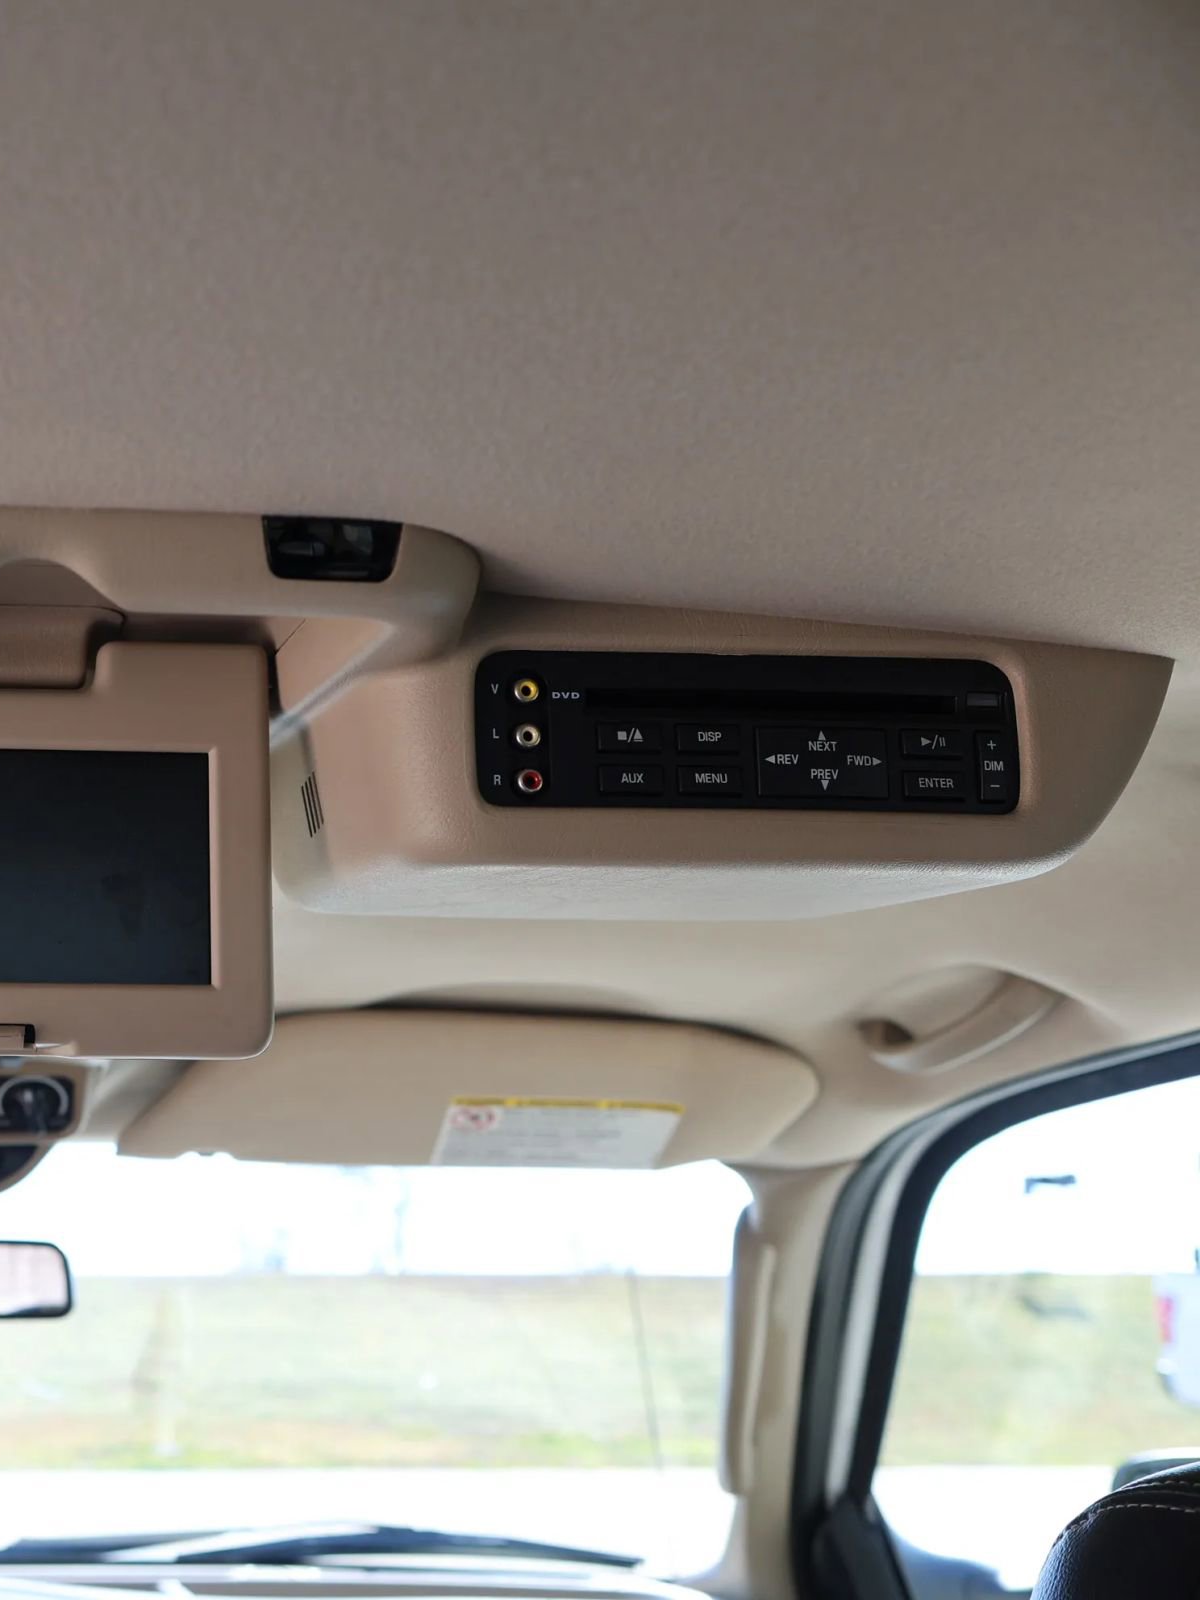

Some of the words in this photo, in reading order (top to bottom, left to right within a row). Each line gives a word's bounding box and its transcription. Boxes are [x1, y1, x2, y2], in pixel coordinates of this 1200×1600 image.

[490, 683, 499, 695] V
[551, 691, 580, 700] DVD
[492, 727, 500, 739] L
[697, 731, 722, 742] DISP
[808, 741, 838, 752] NEXT
[776, 753, 799, 765] REV
[846, 754, 872, 767] FWD
[983, 760, 1004, 772] DIM
[493, 774, 502, 786] R
[620, 772, 644, 784] AUX
[694, 772, 728, 784] MENU
[810, 768, 839, 780] PREV
[918, 777, 954, 789] ENTER
